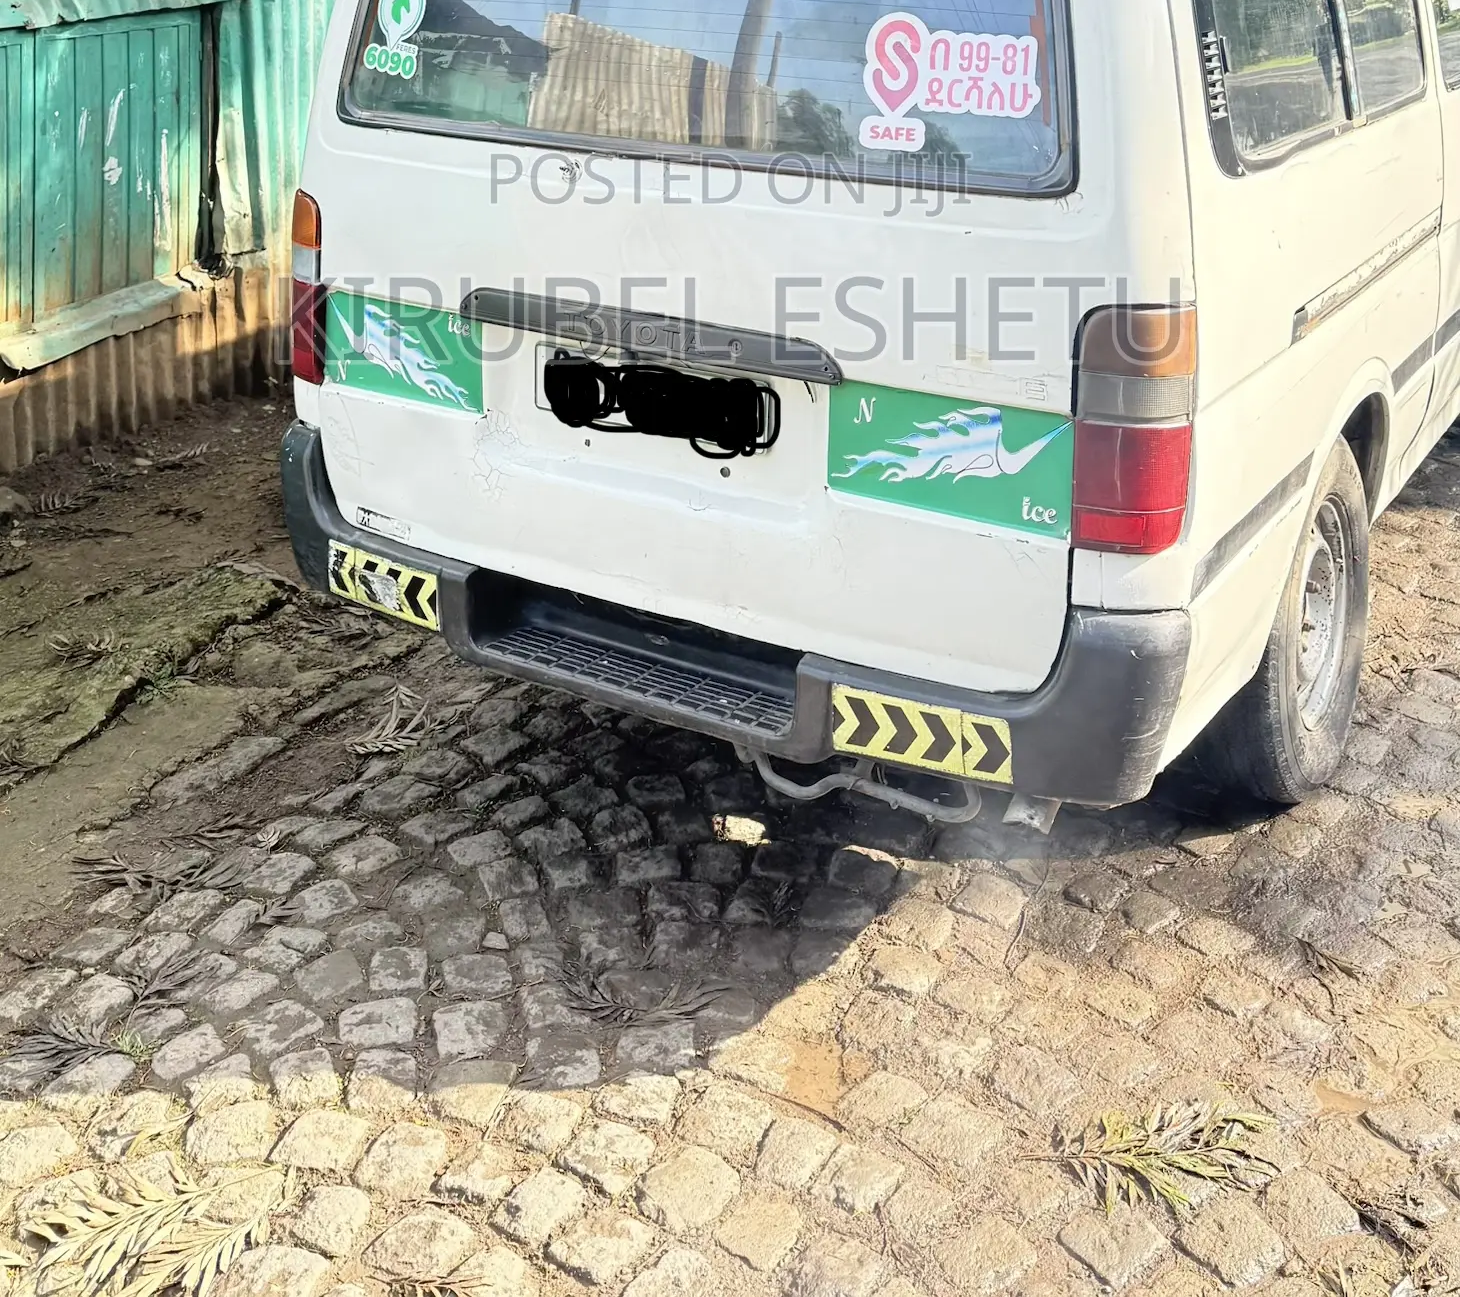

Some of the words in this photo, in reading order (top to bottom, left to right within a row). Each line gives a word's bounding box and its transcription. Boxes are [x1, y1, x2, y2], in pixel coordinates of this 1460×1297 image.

[365, 45, 415, 77] 6090
[396, 43, 416, 55] FERES
[929, 38, 950, 72] በ
[958, 40, 1031, 77] 99-81
[924, 76, 1034, 113] ደርሻለሁ
[868, 124, 917, 143] SAFE
[447, 311, 471, 337] ice
[562, 312, 706, 355] TOYOTA
[853, 396, 877, 424] N
[1021, 496, 1059, 525] ice
